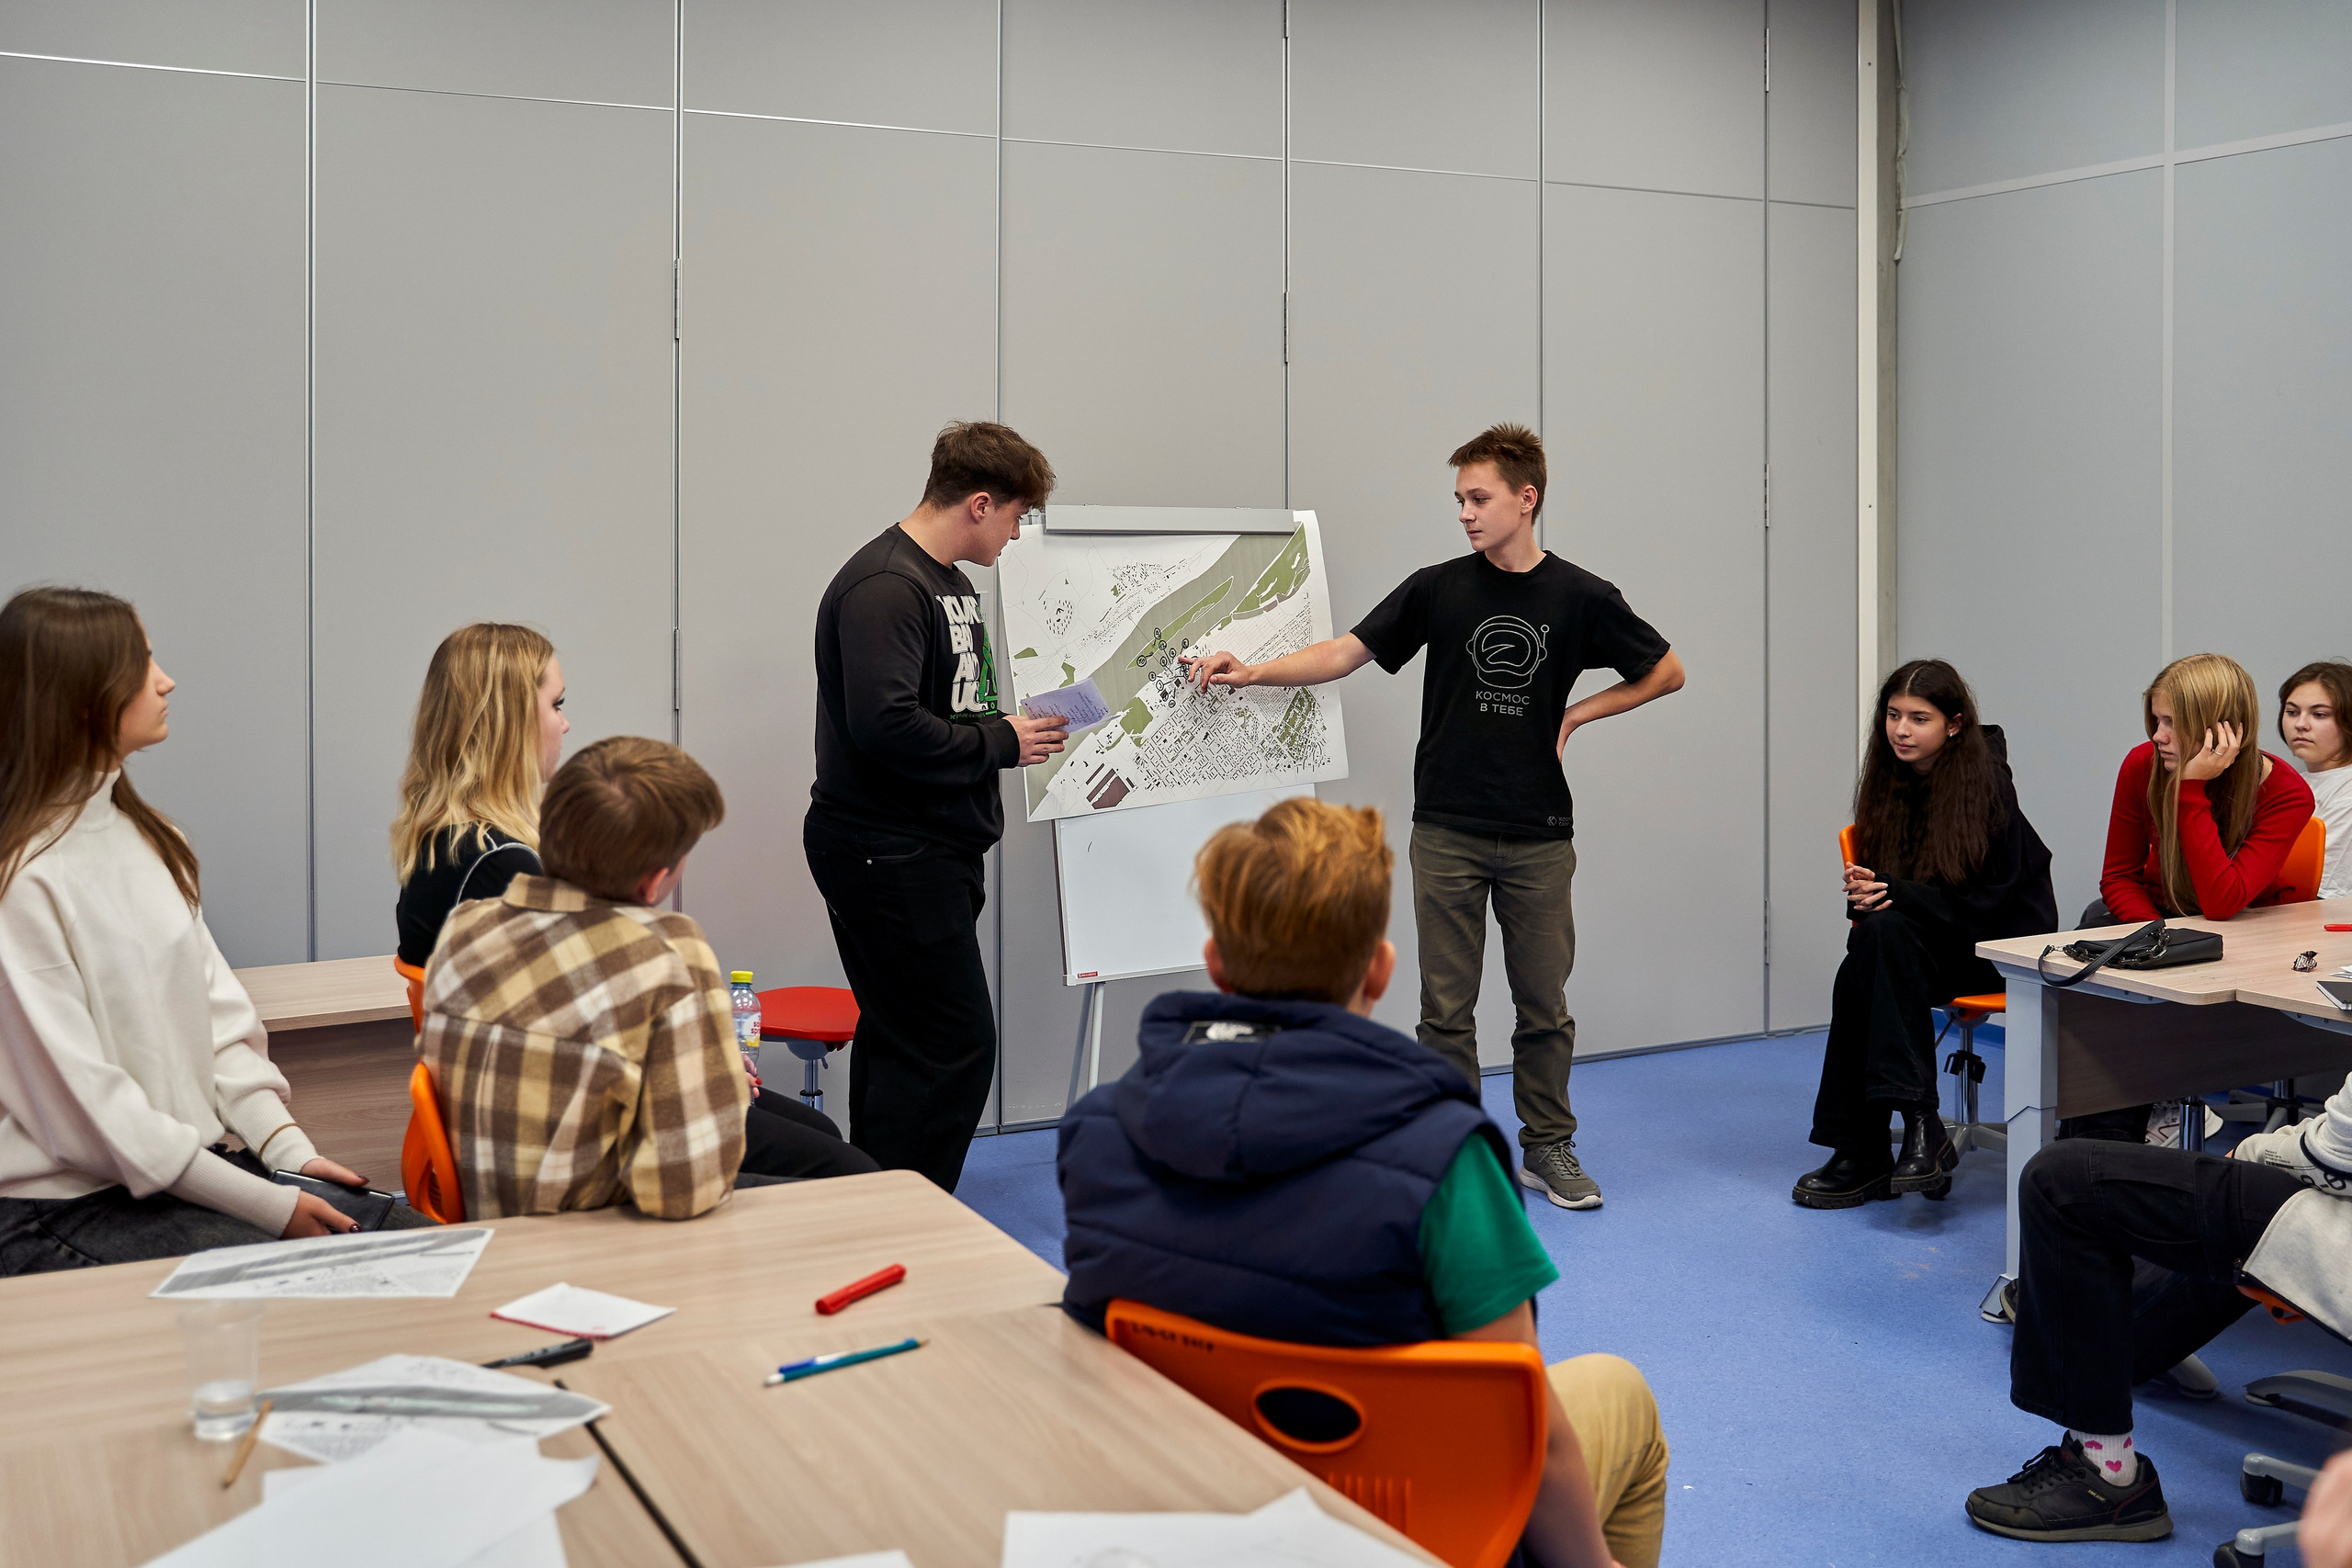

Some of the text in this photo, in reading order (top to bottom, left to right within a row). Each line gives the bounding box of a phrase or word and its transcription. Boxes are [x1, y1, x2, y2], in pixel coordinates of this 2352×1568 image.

[1475, 690, 1530, 705] КОСМОС
[1480, 703, 1523, 716] В ТЕБЕ
